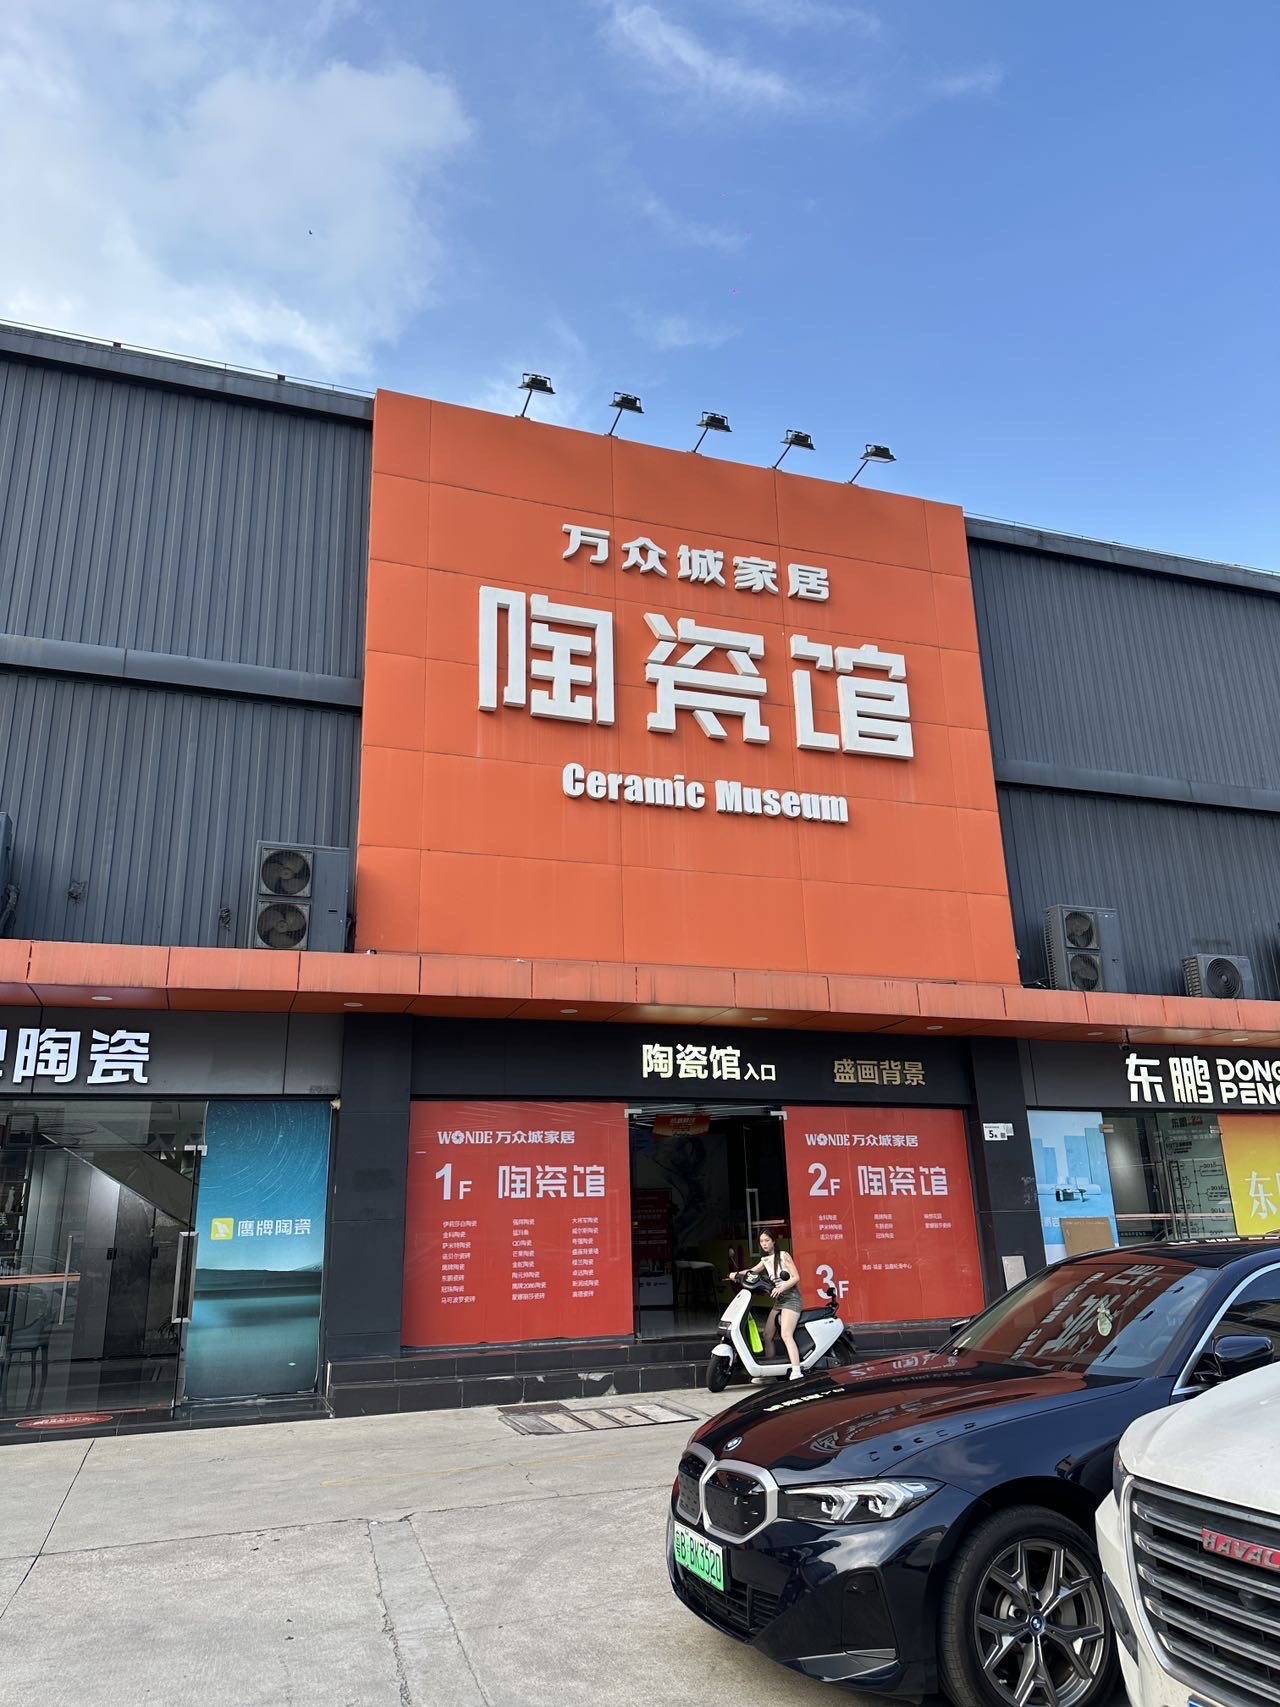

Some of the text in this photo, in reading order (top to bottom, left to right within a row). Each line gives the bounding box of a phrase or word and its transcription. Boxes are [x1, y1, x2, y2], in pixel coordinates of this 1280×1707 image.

[562, 523, 830, 602] 万众城家居
[478, 585, 914, 760] 陶瓷馆
[562, 762, 849, 824] Ceramic Museum
[0, 1028, 150, 1084] 陶瓷
[834, 1059, 925, 1085] 盛画背景
[1126, 1053, 1213, 1103] 东鹏
[1219, 1081, 1280, 1105] PEN
[496, 1131, 574, 1144] 万众城家居
[852, 1134, 919, 1147] 万众城家居
[435, 1163, 606, 1200] 1F 陶瓷馆
[807, 1162, 949, 1197] 2F 陶瓷馆
[1244, 1170, 1280, 1219] 东
[238, 1218, 312, 1237] 鹰牌陶瓷
[815, 1264, 850, 1299] 3F
[1203, 1531, 1280, 1568] HAVAL
